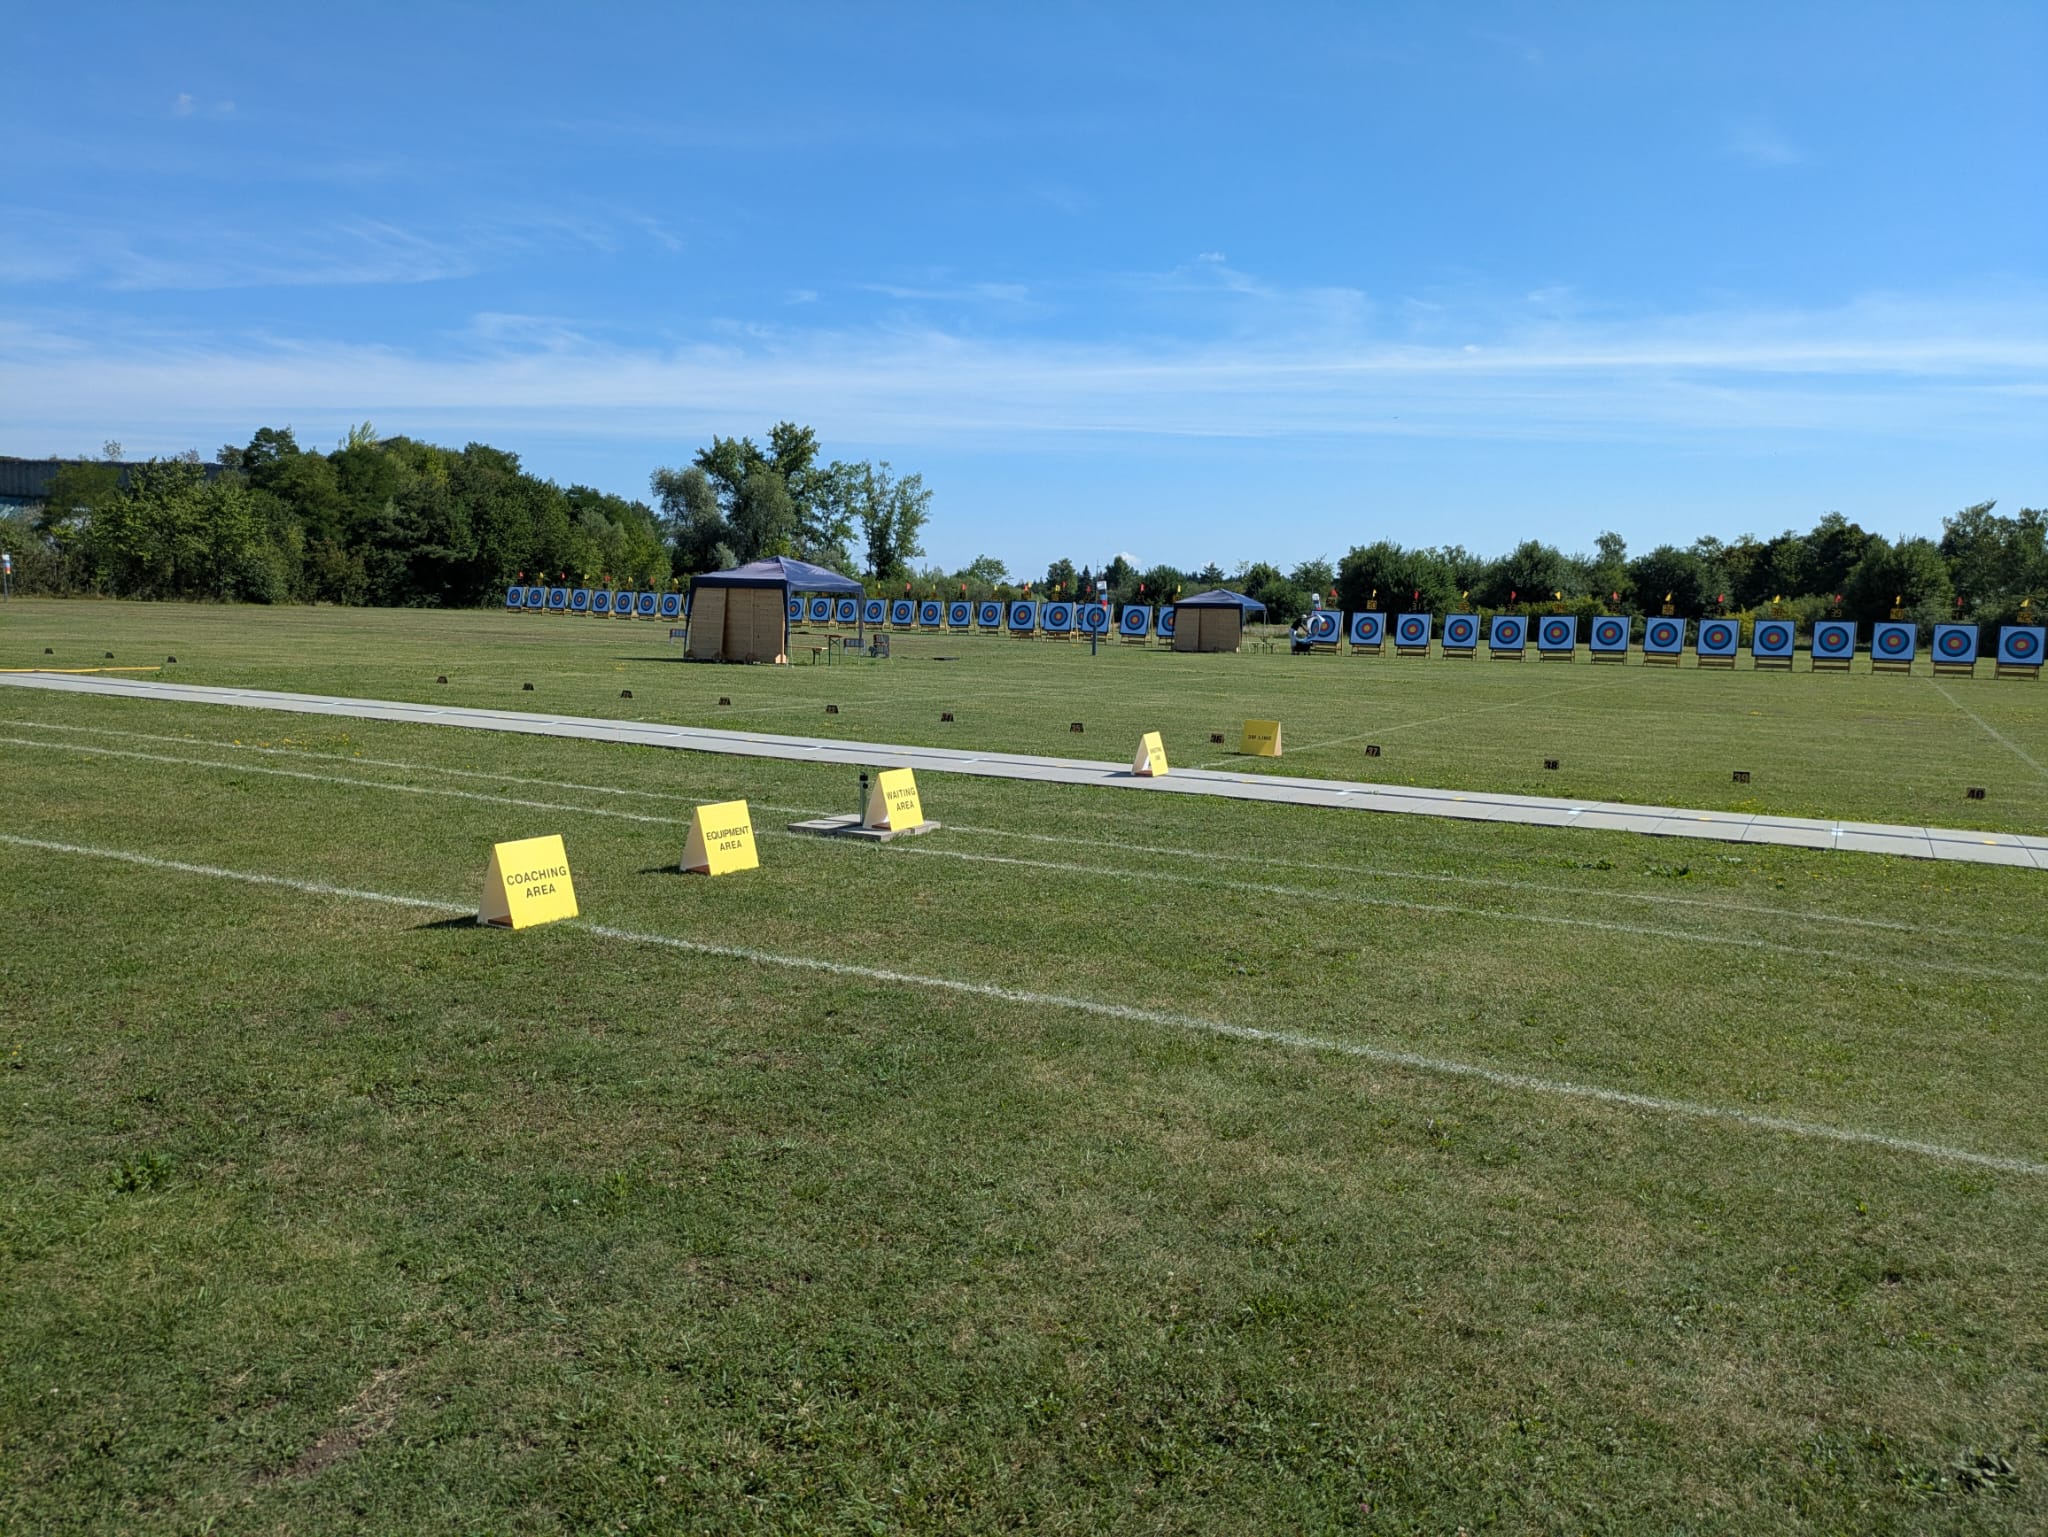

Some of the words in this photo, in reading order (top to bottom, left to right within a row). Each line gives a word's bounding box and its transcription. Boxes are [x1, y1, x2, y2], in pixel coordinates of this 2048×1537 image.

[1368, 747, 1378, 757] 37
[1735, 773, 1748, 783] 39
[886, 787, 916, 800] WAITING
[896, 800, 915, 811] AREA
[706, 825, 749, 841] EQUIPMENT
[719, 840, 742, 851] AREA
[506, 866, 567, 886] COACHING
[526, 883, 556, 898] AREA
